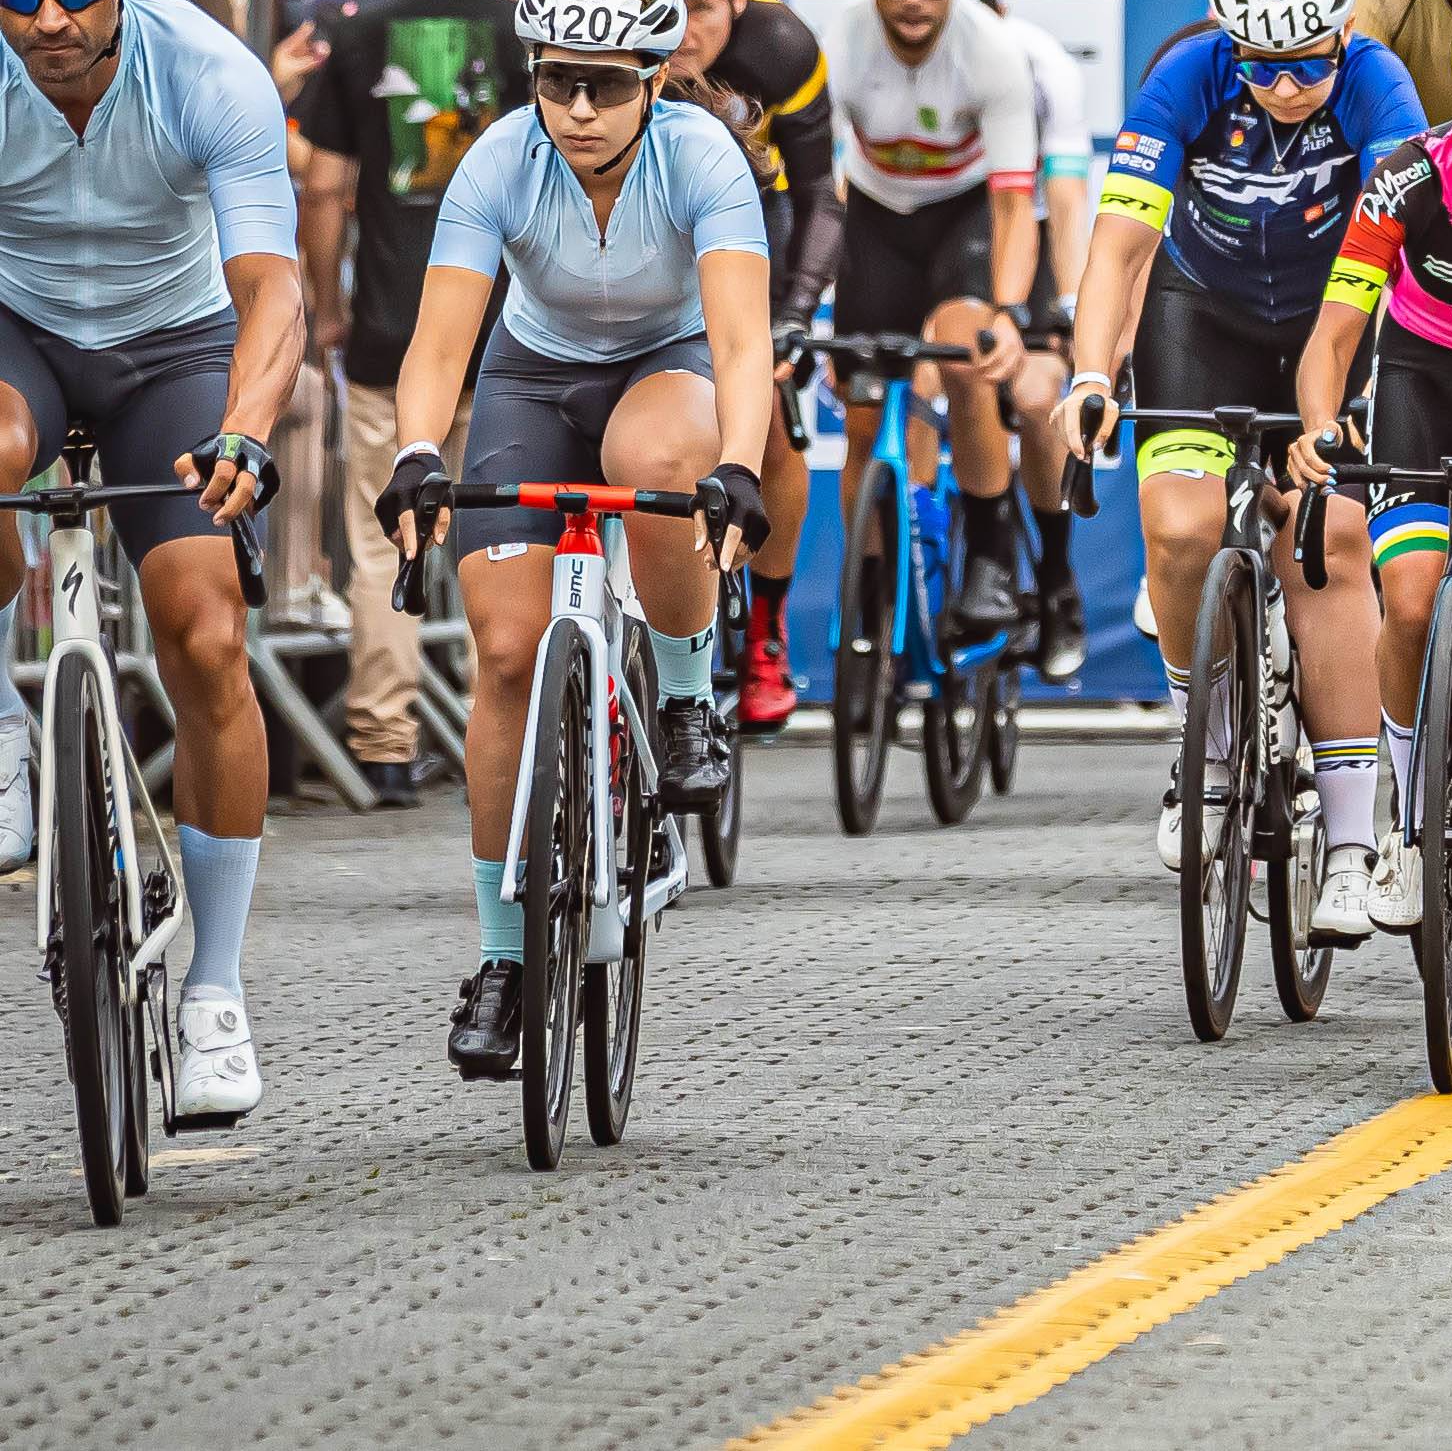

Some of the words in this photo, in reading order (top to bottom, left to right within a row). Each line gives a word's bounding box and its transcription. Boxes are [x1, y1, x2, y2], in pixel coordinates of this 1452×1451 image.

[540, 5, 639, 47] 1207
[1237, 1, 1323, 41] 1118
[568, 558, 584, 609] BMC
